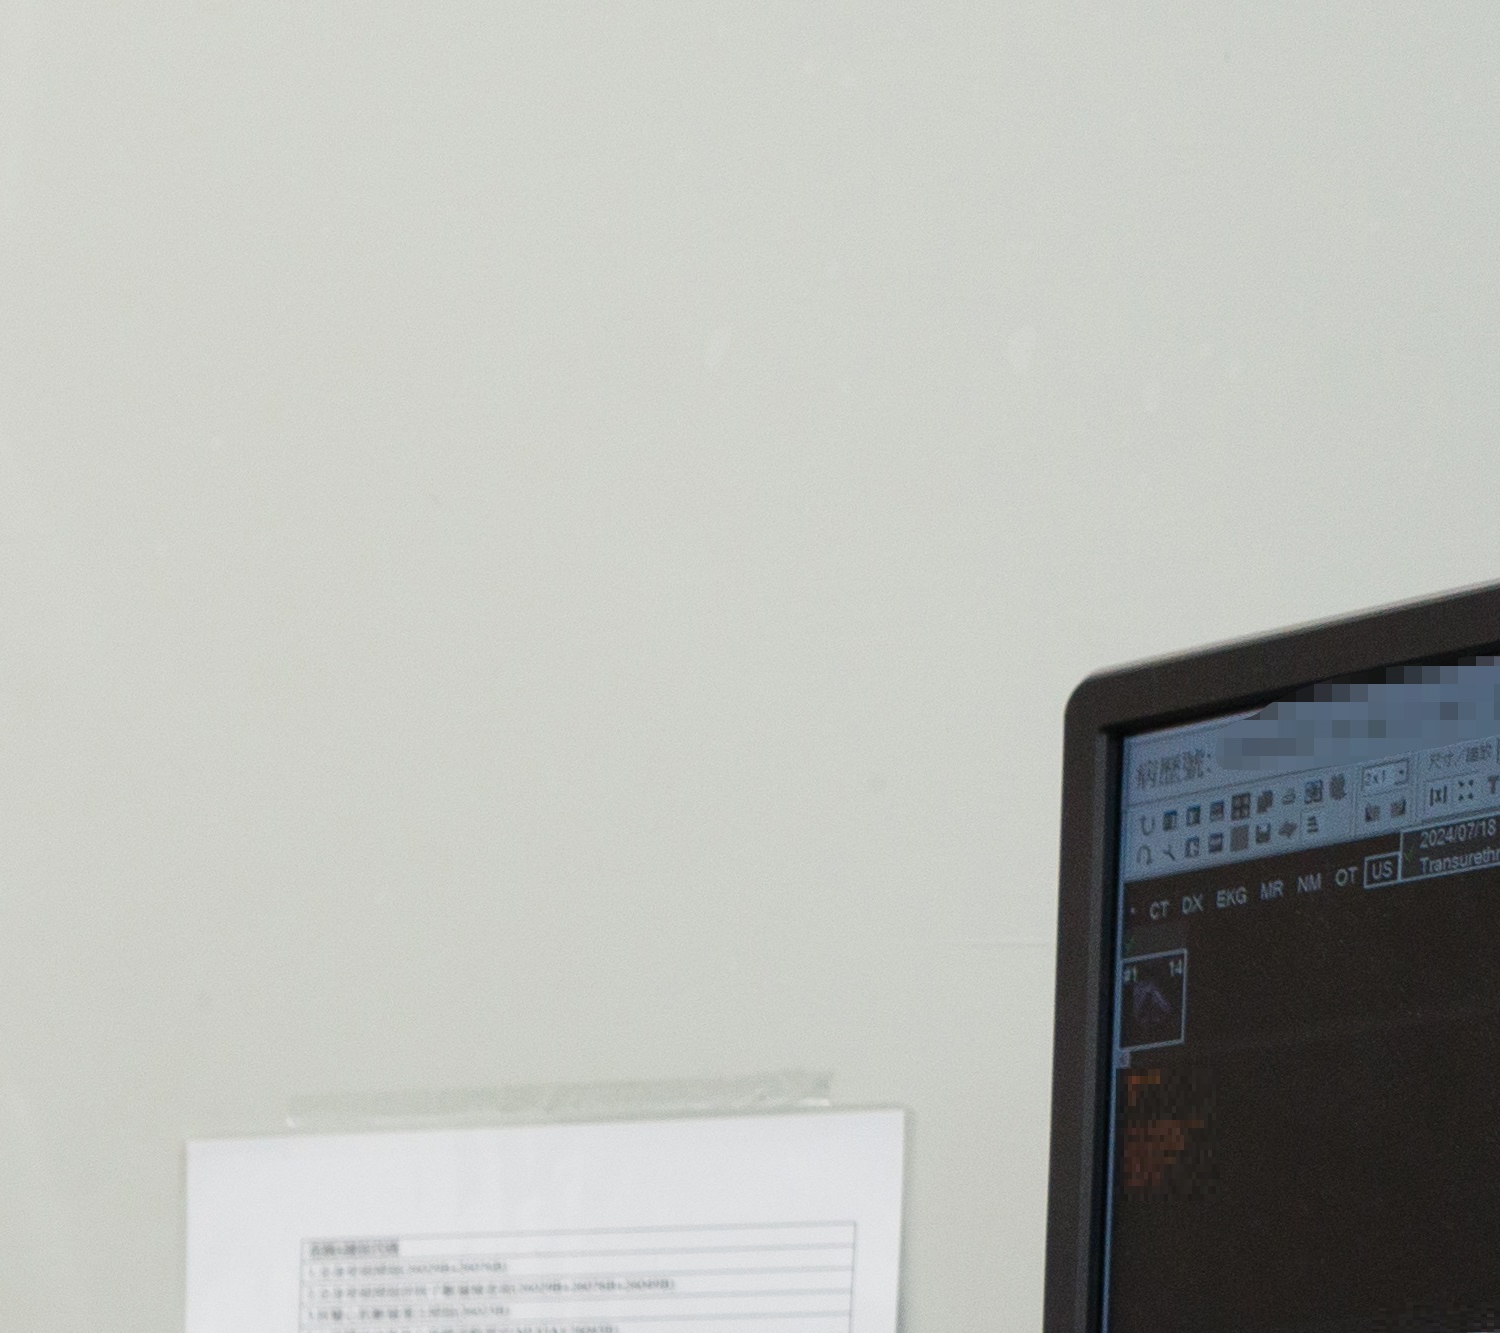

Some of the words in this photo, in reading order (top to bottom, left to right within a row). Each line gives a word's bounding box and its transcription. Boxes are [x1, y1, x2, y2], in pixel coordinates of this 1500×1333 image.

[1420, 818, 1496, 849] 2024/07/18
[1149, 900, 1170, 920] CT
[1182, 893, 1204, 915] DX
[1216, 886, 1247, 909] EKG
[1260, 879, 1284, 900] MR
[1297, 872, 1323, 893] NM
[1335, 866, 1359, 887] OT
[1371, 860, 1394, 881] US
